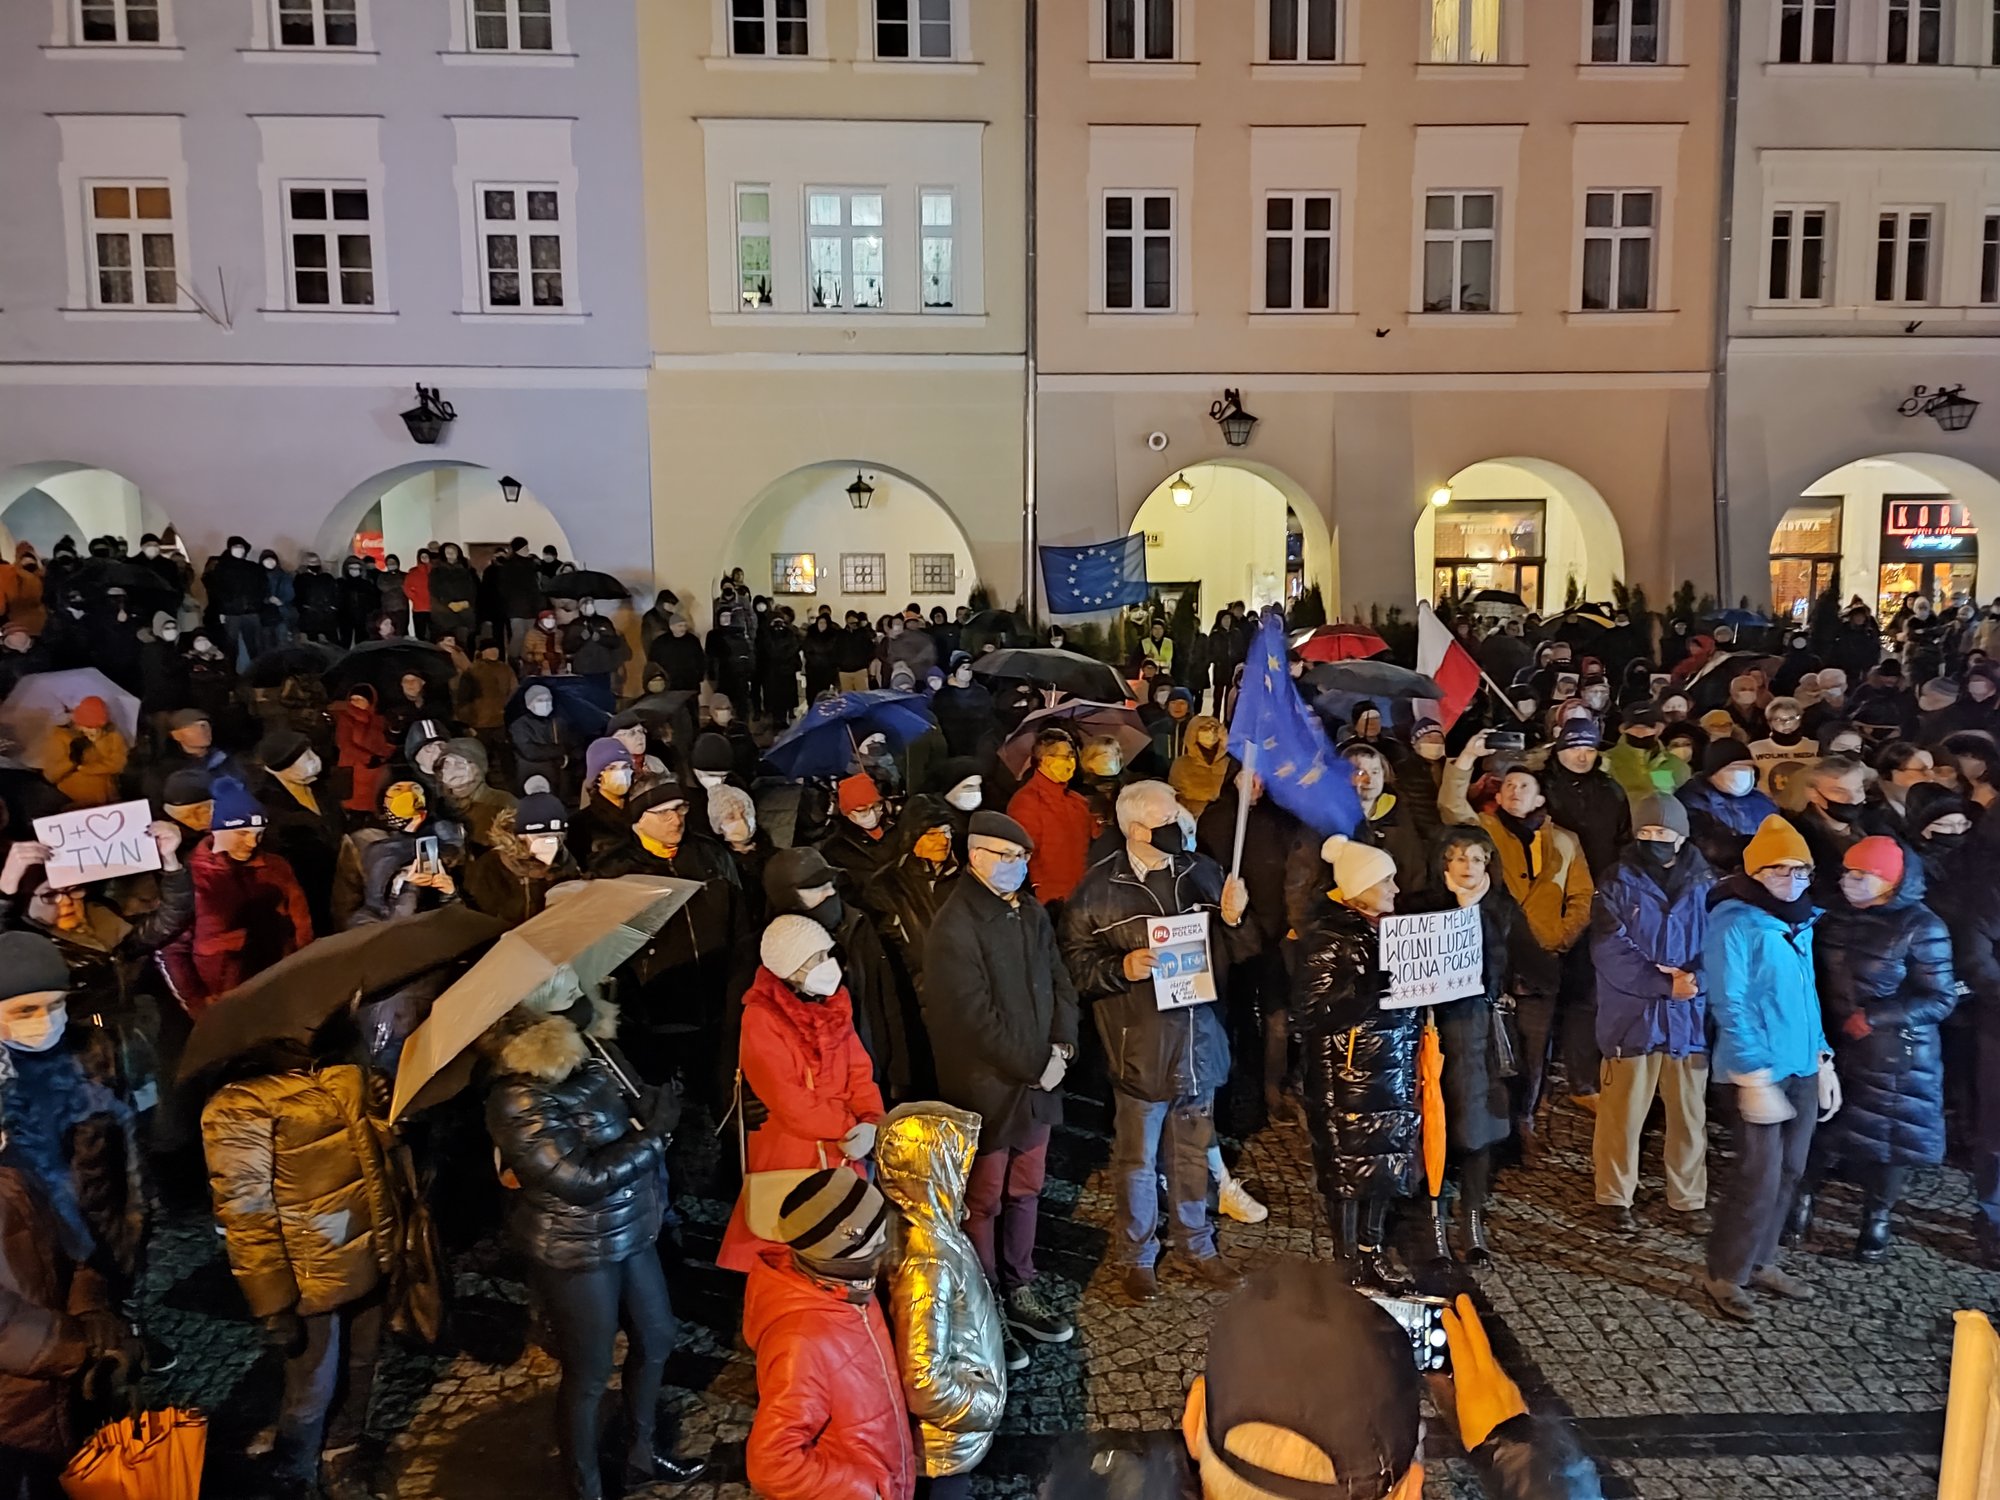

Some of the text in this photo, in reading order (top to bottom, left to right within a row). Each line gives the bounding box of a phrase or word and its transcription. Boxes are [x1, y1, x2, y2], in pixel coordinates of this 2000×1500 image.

[66, 837, 142, 874] TVN
[1385, 915, 1437, 939] WOLNE
[1386, 926, 1477, 964] WOLNI LUDZIE
[1387, 949, 1482, 985] WOLNA POLSKA
